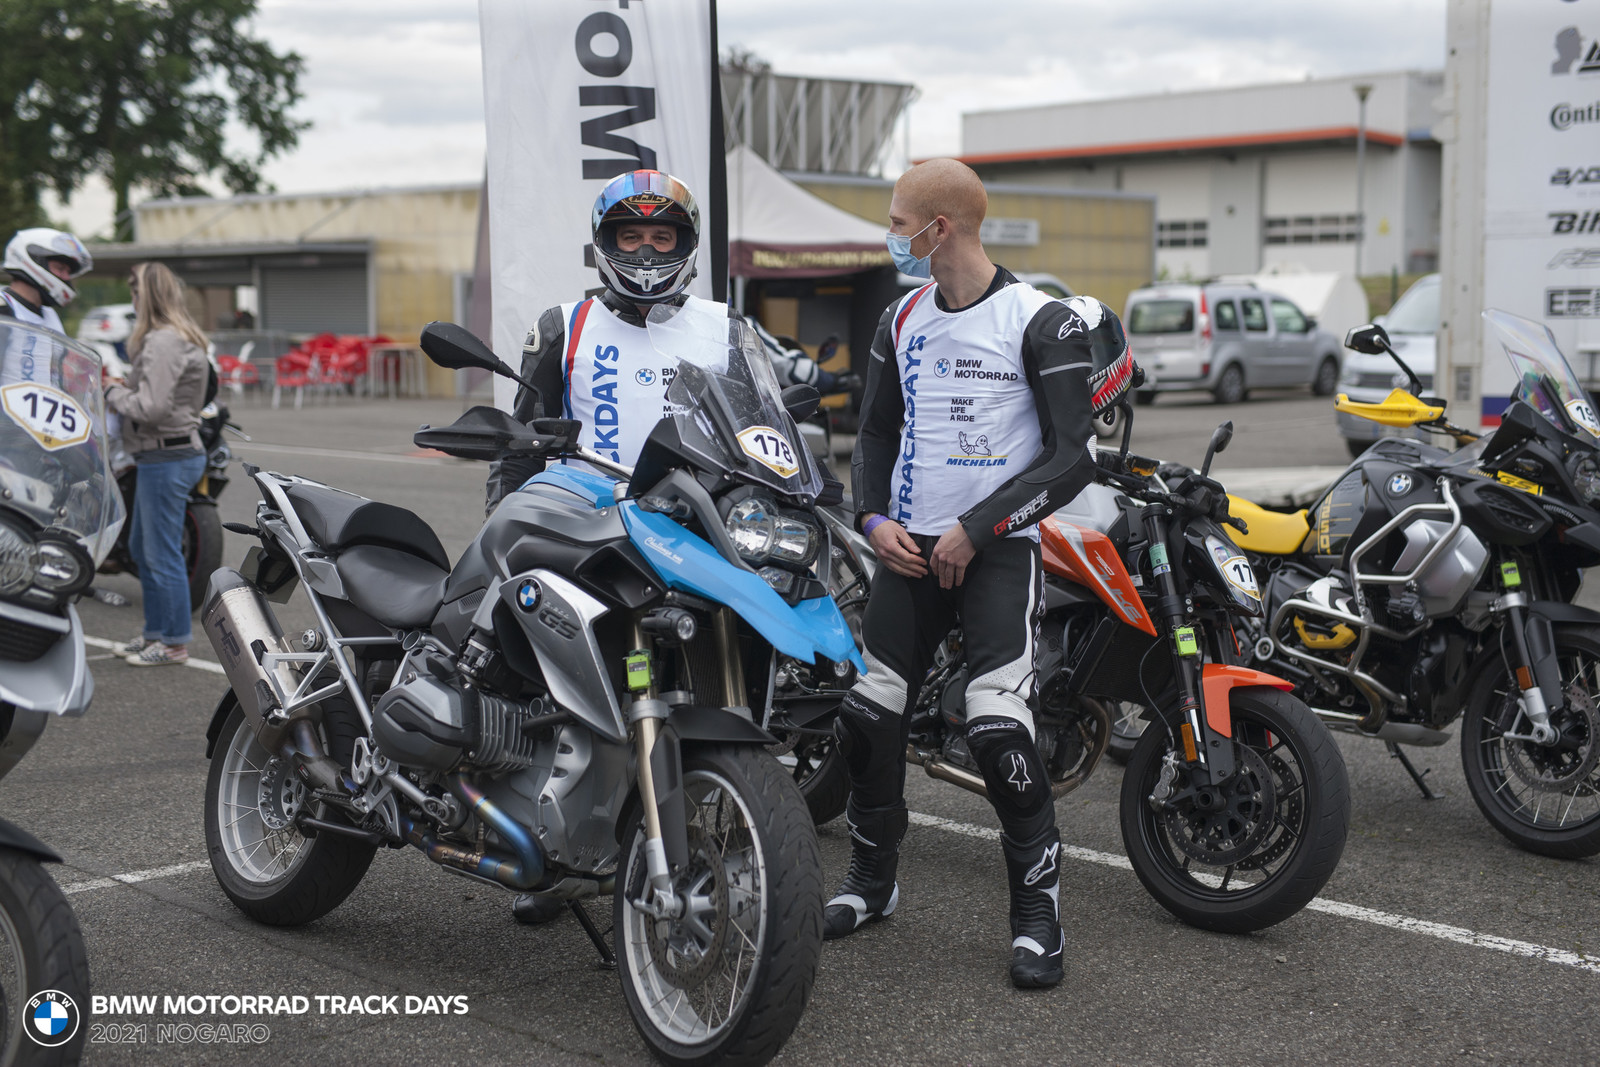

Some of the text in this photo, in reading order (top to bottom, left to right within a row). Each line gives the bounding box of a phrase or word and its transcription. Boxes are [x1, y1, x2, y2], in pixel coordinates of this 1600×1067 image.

[955, 359, 982, 369] BMW
[662, 368, 678, 376] BM
[954, 369, 1019, 382] MOTORRAD
[951, 398, 974, 406] MAKE
[22, 391, 77, 433] 175
[950, 406, 966, 414] LIFE
[950, 414, 975, 423] A RIDE
[753, 433, 794, 465] 178
[946, 457, 1007, 467] MICHELIN
[1007, 493, 1050, 531] FORCE
[993, 516, 1011, 536] GP
[539, 608, 580, 641] GS
